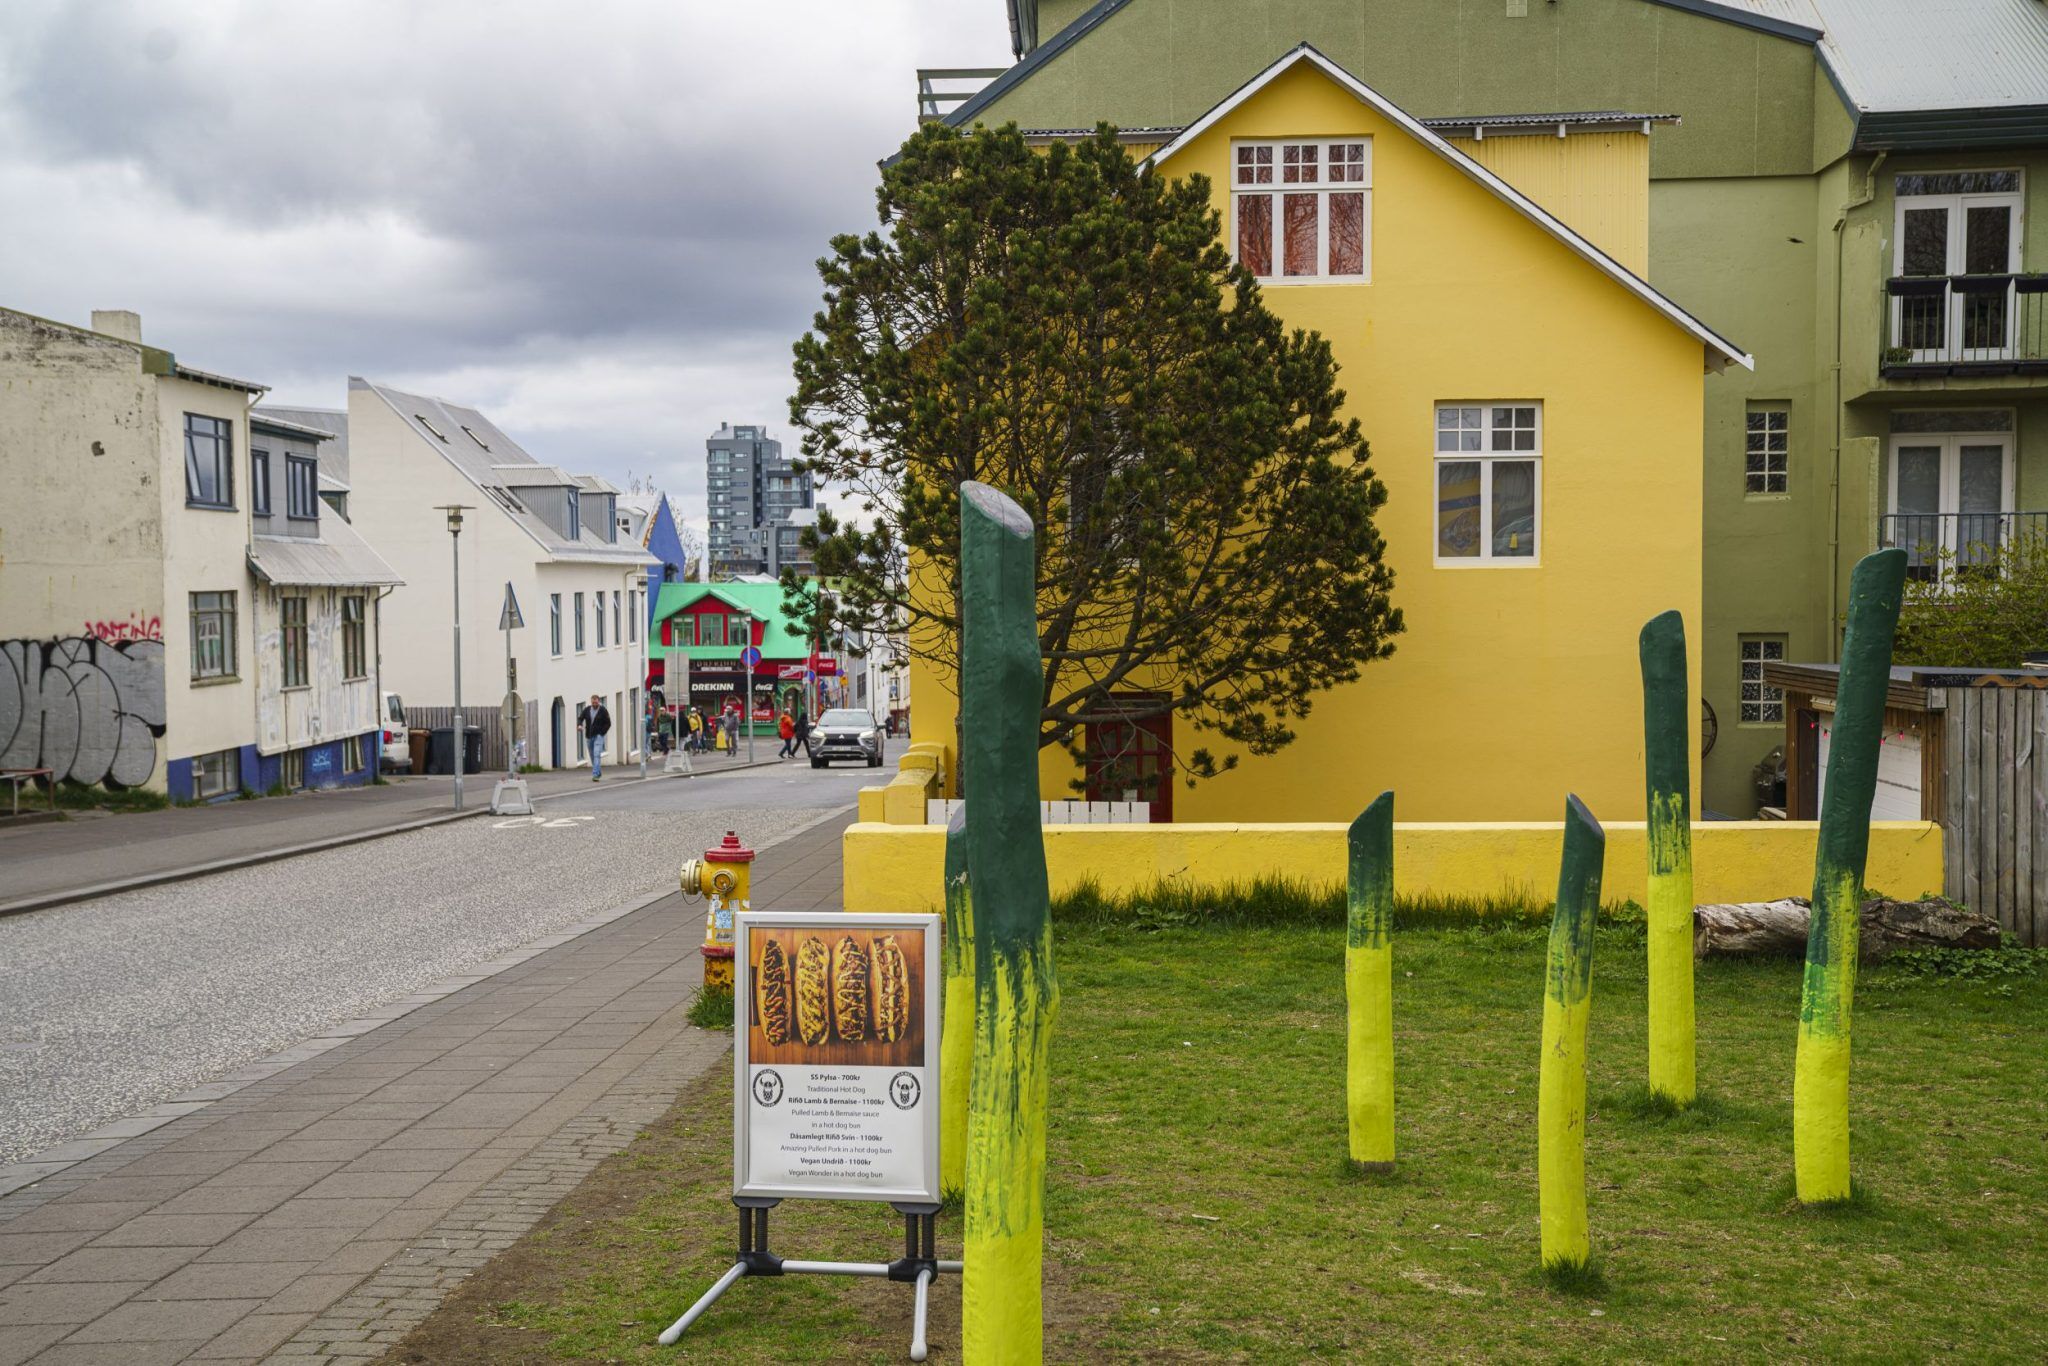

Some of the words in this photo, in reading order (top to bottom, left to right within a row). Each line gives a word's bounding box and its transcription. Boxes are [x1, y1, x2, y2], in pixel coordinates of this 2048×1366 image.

[691, 683, 734, 691] DREKINN
[820, 1074, 836, 1082] Pylsa
[807, 1085, 839, 1093] Traditional
[835, 1122, 848, 1130] dog
[790, 1132, 824, 1141] Dásamlegt
[780, 1145, 807, 1153] Amazing
[788, 1169, 808, 1177] Vegan
[857, 1171, 870, 1179] dog
